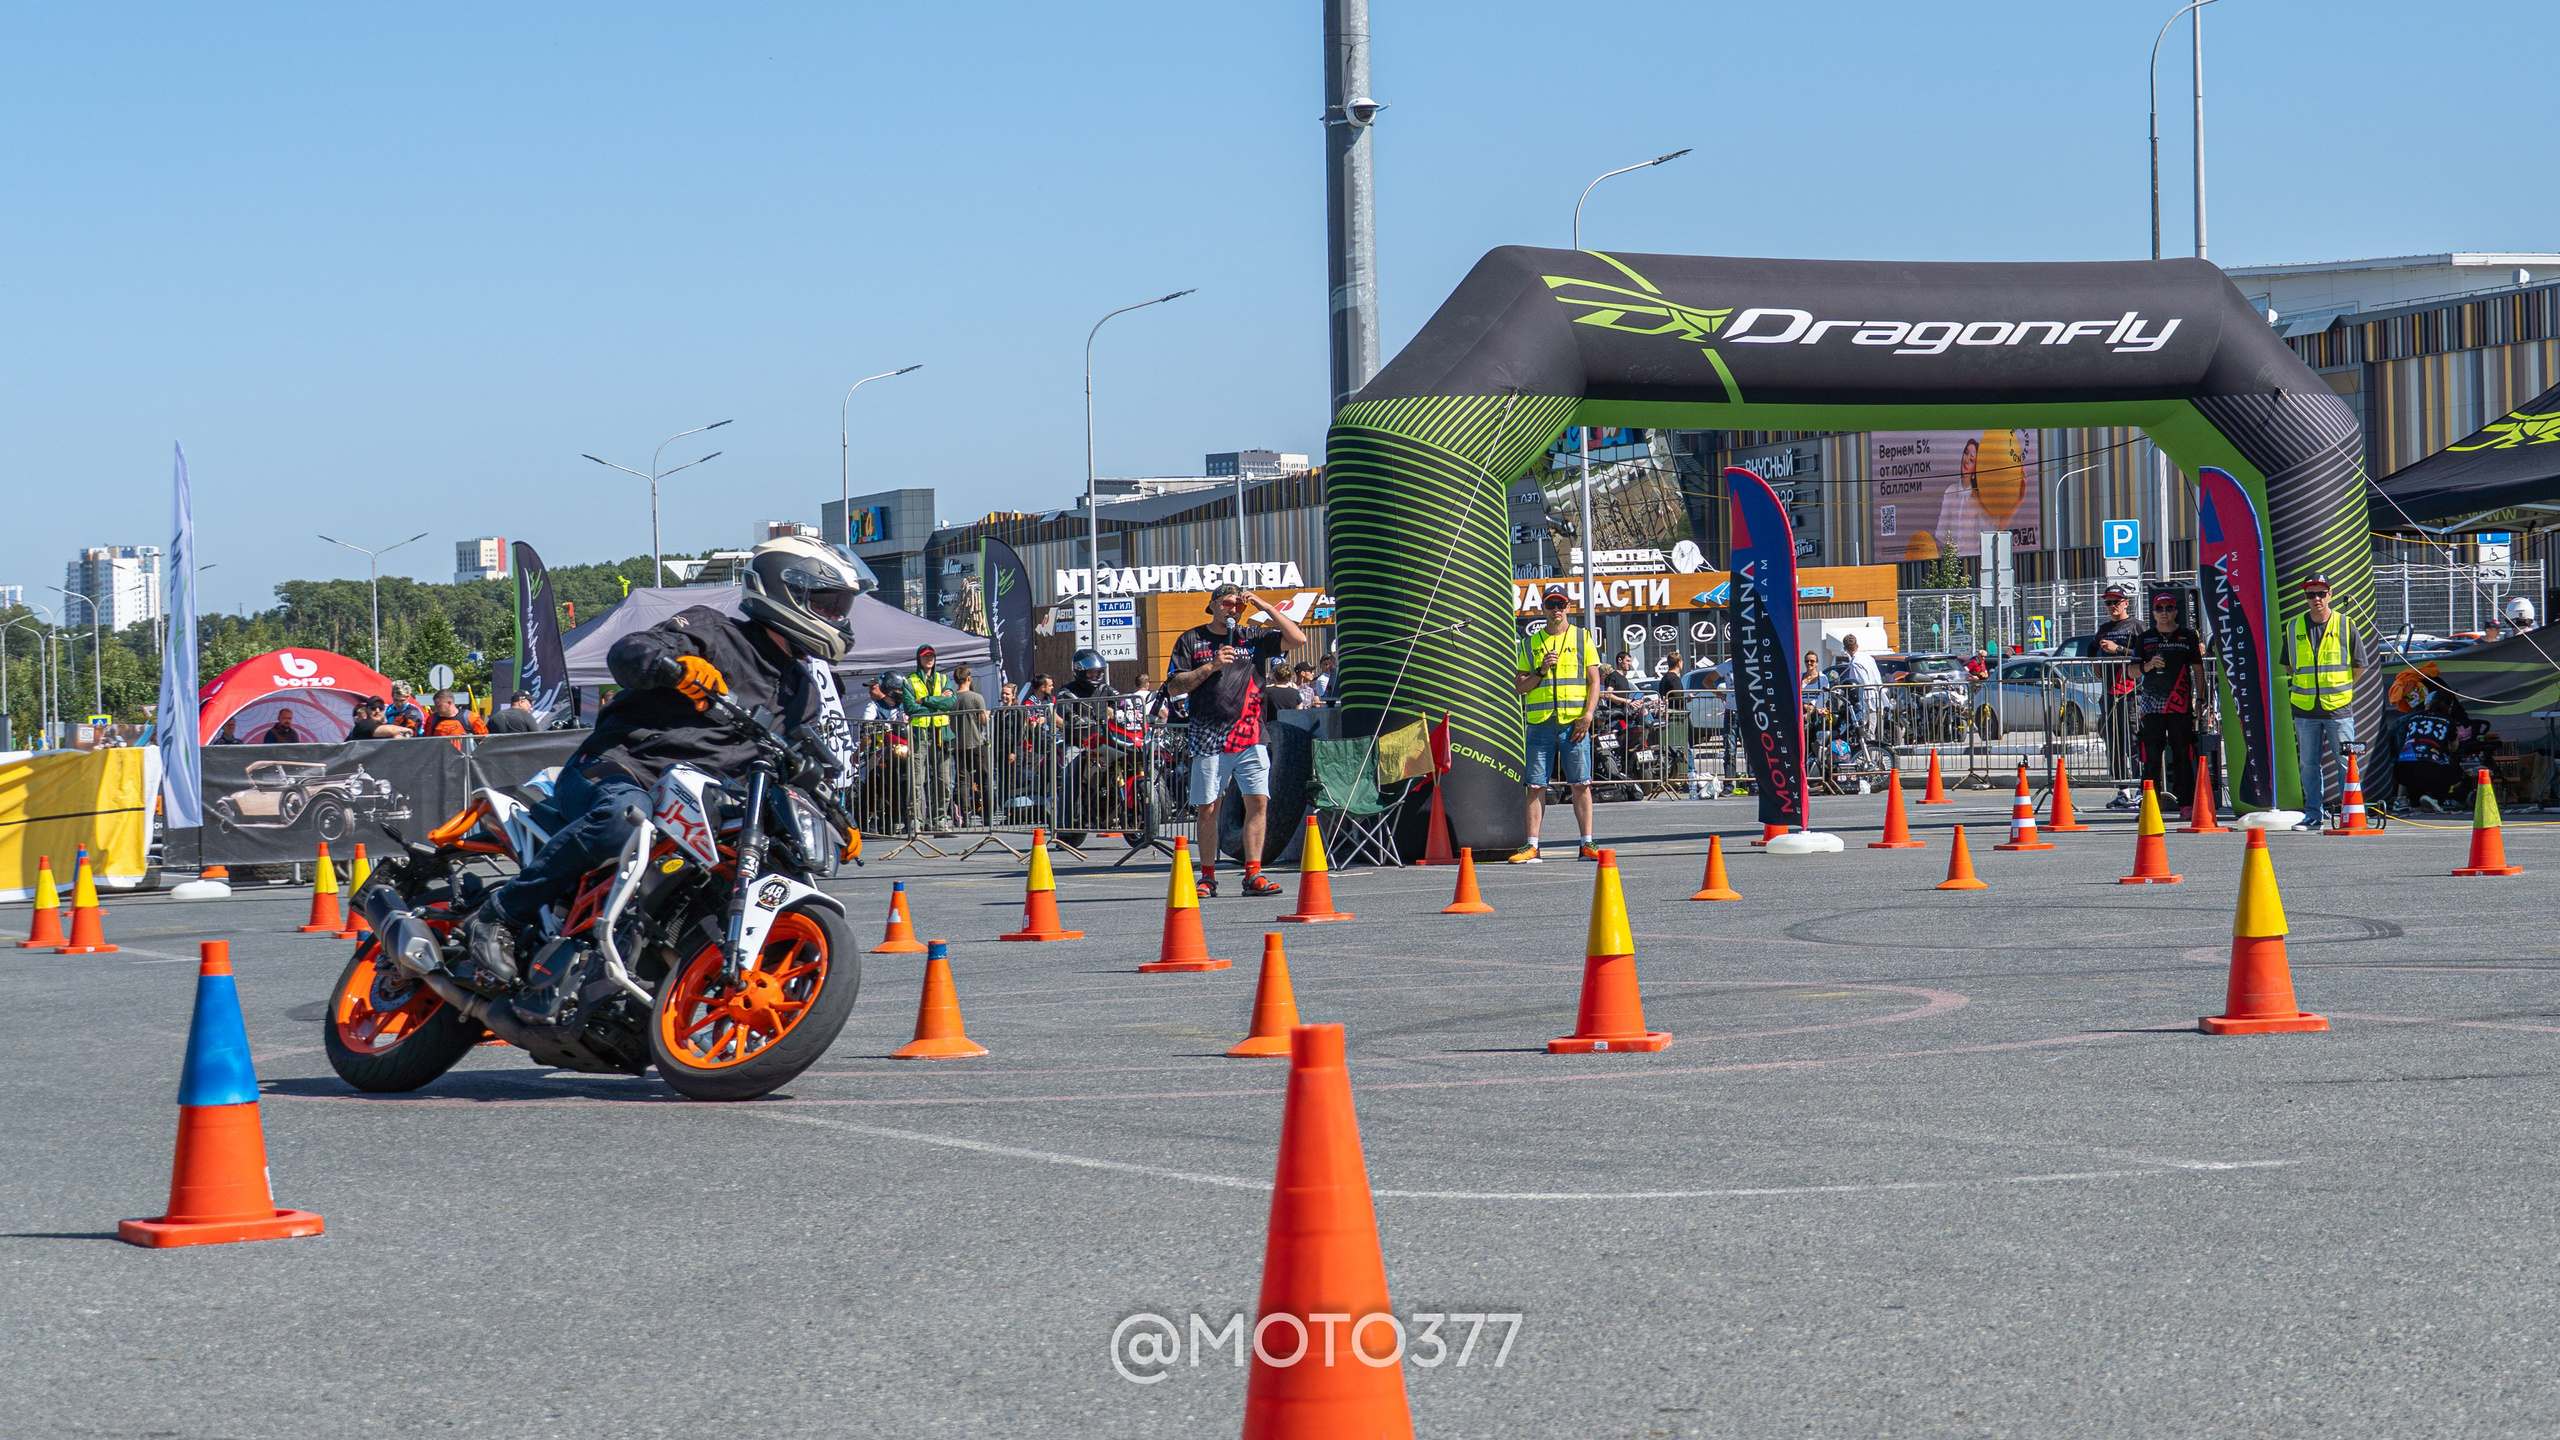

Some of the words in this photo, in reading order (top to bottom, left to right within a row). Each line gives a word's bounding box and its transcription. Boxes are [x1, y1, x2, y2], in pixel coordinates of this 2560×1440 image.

[1721, 307, 2182, 355] Dragonfly
[1879, 444, 1914, 461] Вернем
[1916, 439, 1931, 454] 5%
[1879, 466, 1891, 477] от
[1892, 461, 1931, 477] покупок
[1880, 481, 1922, 496] баллами
[2113, 525, 2133, 554] P
[2231, 551, 2241, 607] TEAM
[1513, 578, 1670, 611] ЗАЧАСТИ
[1098, 602, 1131, 611] .ТАГИЛ
[1099, 618, 1124, 626] ЕРМЬ
[1099, 633, 1122, 641] ЕНТР
[1101, 648, 1130, 656] ОКЗАЛ
[273, 675, 335, 687] borzo
[1740, 560, 1794, 814] MOTOGYMKHANA
[1762, 638, 1802, 814] EKATERINBURG
[1450, 742, 1521, 783] GONFLY.SU
[670, 783, 701, 814] 390
[764, 884, 785, 898] 48
